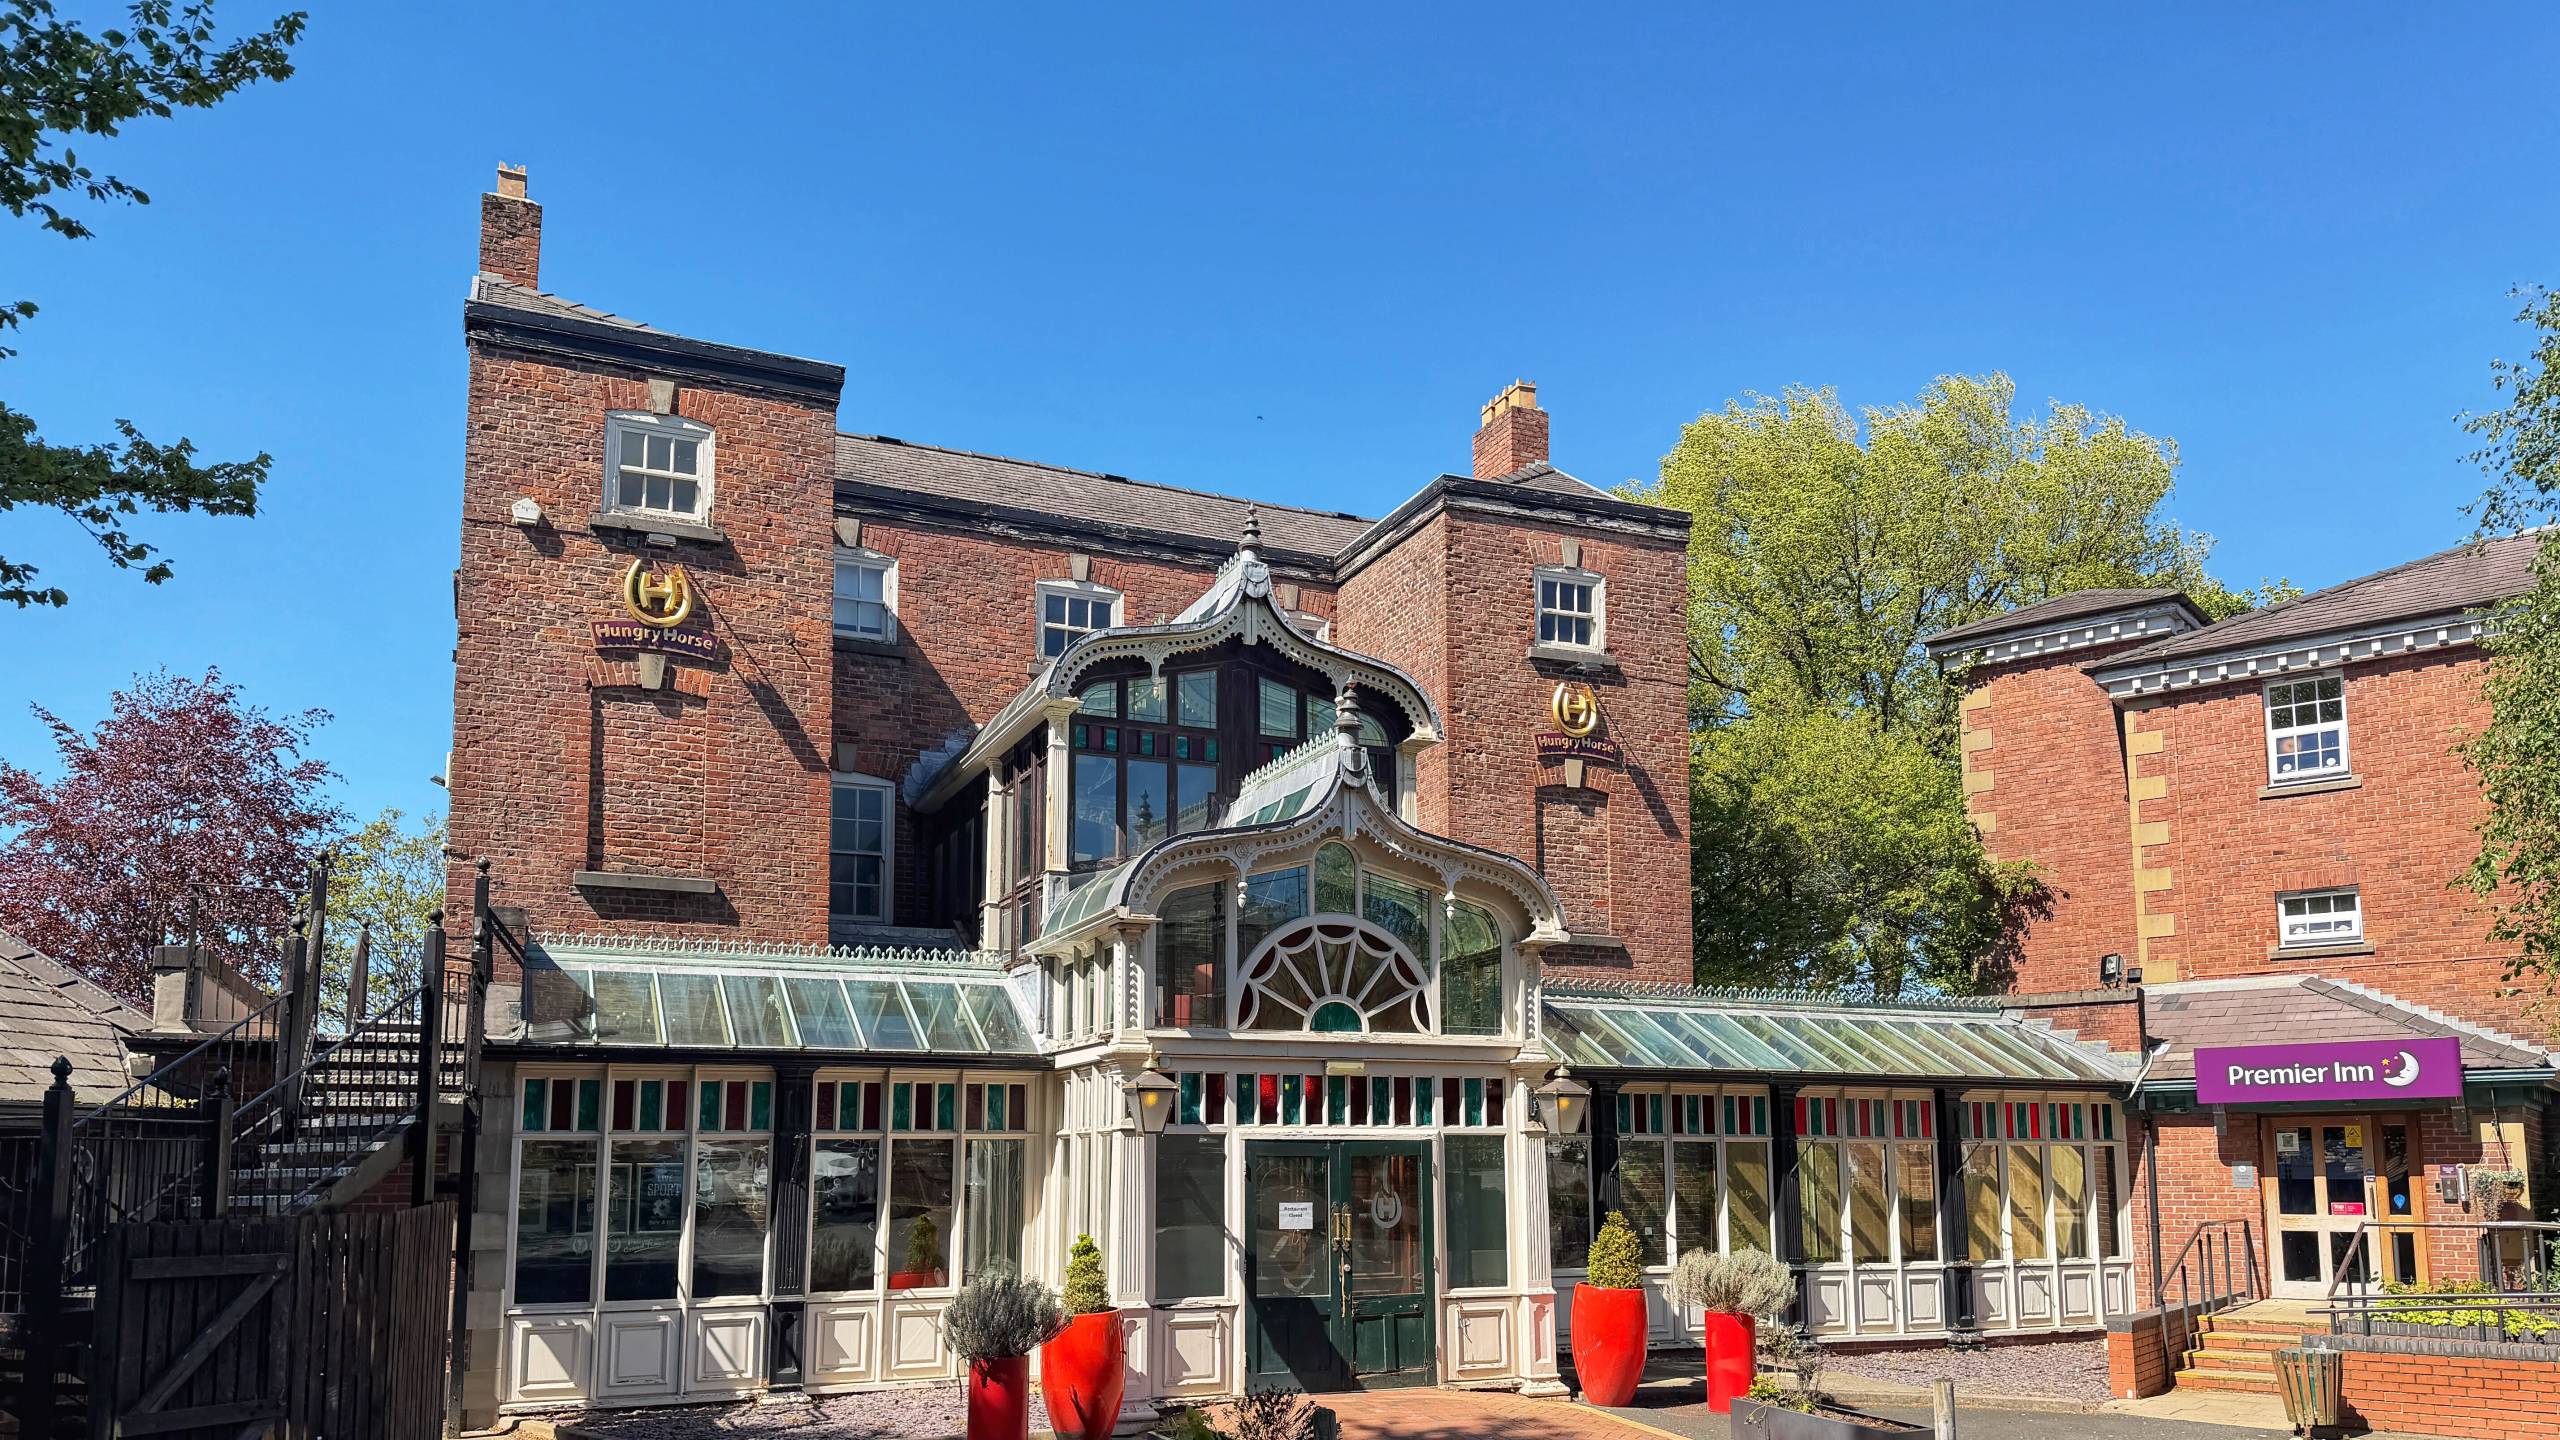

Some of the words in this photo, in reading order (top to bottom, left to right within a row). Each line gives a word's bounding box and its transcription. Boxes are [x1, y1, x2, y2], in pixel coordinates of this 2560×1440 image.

[595, 623, 661, 643] Hungry
[663, 628, 713, 650] Horse
[1537, 735, 1580, 749] Hungry
[1581, 737, 1615, 754] Horse
[2228, 1062, 2329, 1086] Premier
[2333, 1061, 2375, 1083] Inn
[657, 1174, 673, 1182] LIVE
[647, 1183, 682, 1197] SPORT
